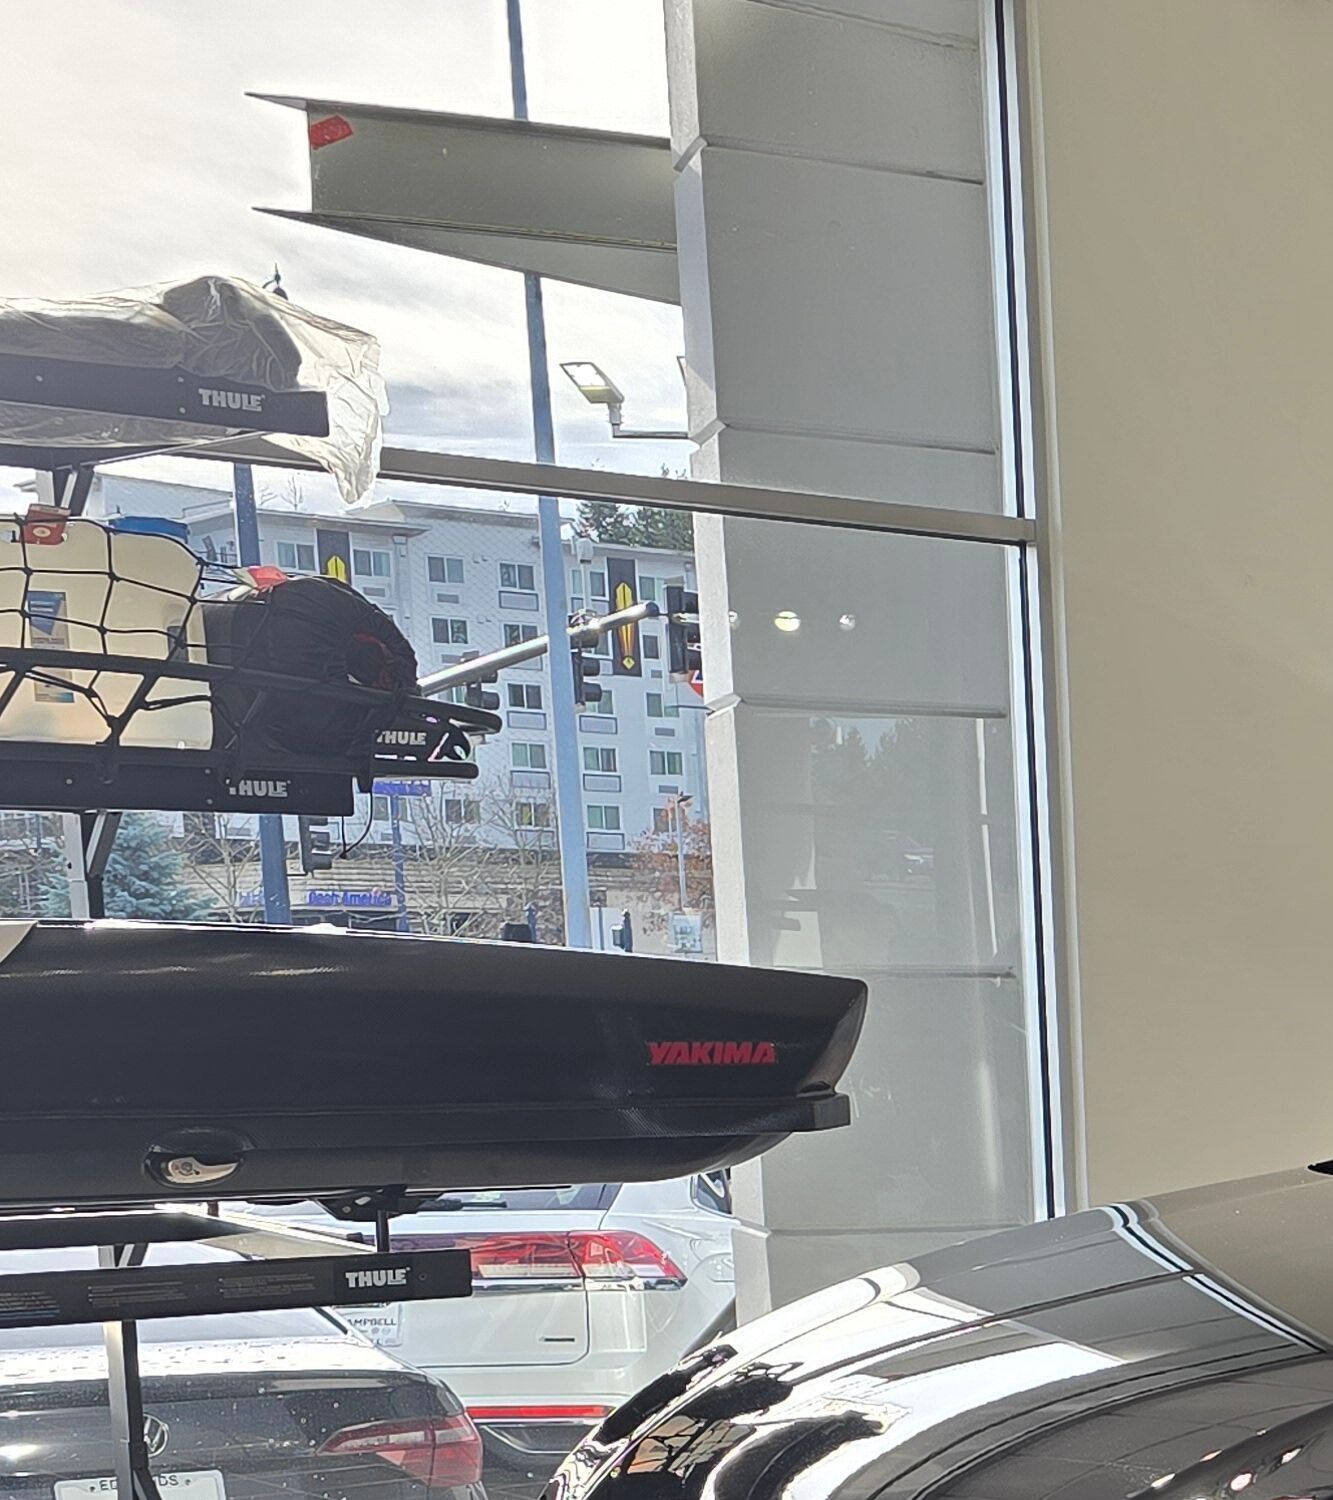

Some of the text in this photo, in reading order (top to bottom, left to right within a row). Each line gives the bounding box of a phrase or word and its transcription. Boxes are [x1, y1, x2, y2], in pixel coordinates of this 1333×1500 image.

[198, 388, 263, 412] THULE
[648, 1041, 776, 1065] YAKIMA
[345, 1268, 407, 1288] THULE
